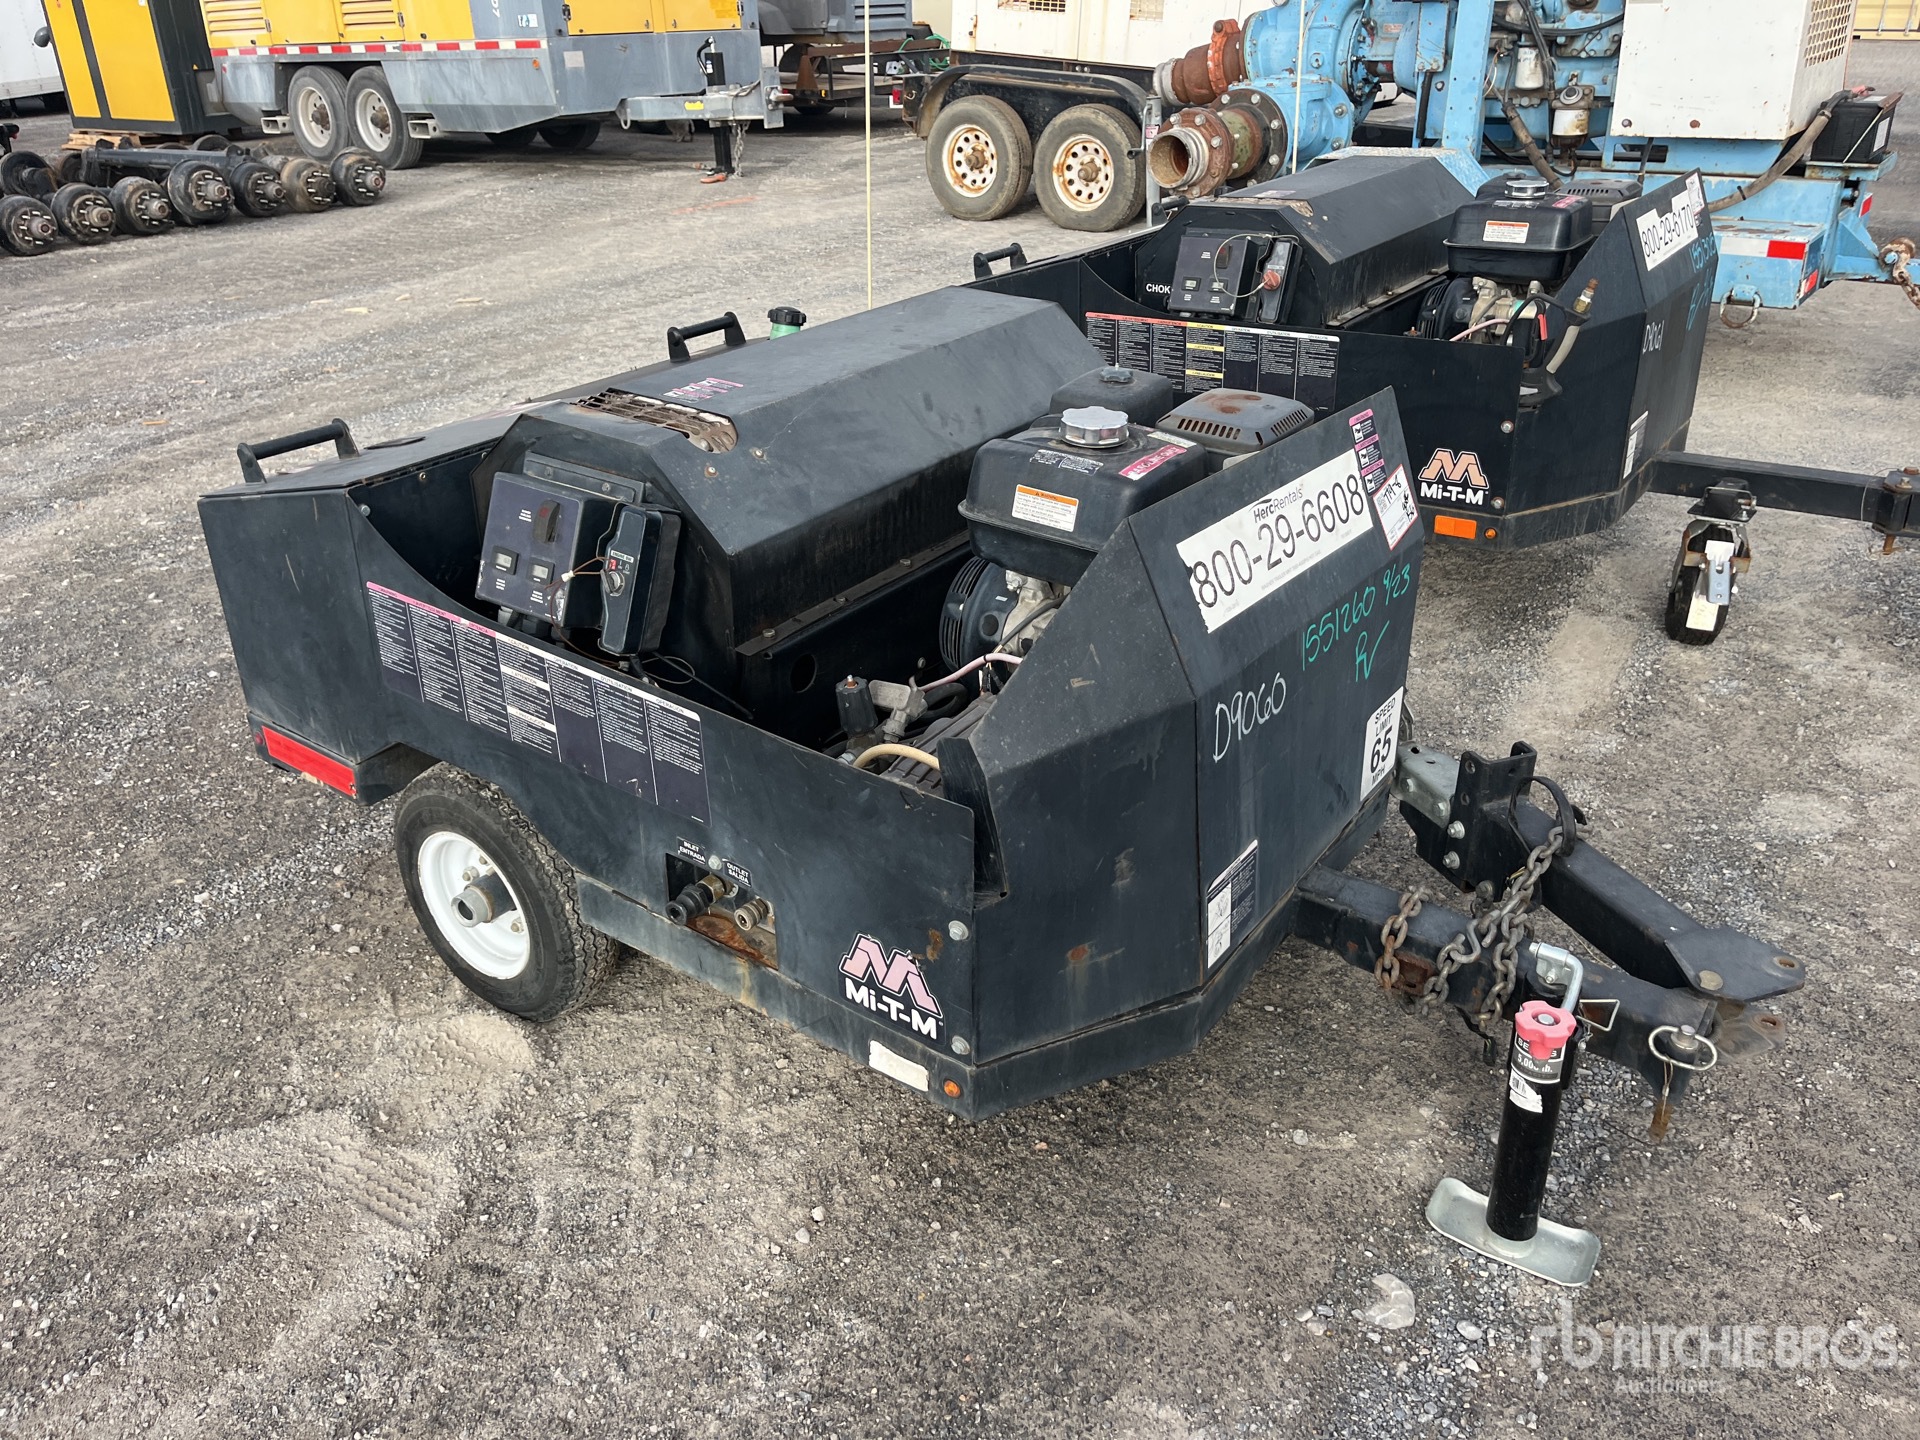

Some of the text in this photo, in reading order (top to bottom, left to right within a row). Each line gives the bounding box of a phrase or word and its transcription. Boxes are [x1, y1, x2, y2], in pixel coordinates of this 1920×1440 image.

[1641, 203, 1695, 259] 800-29-6170
[1145, 283, 1174, 295] CHOK
[1253, 485, 1304, 525] HercRentals
[1420, 481, 1485, 506] Mi-T-M
[1192, 474, 1365, 609] 800-29-6608
[1302, 586, 1376, 671] 1551260
[1212, 671, 1287, 764] D9060
[1374, 696, 1396, 725] SPEED
[1375, 712, 1393, 738] LIMIT
[1370, 724, 1393, 774] 65
[1371, 763, 1386, 786] MPH
[679, 846, 706, 862] ENTRADA
[683, 841, 700, 852] INLET
[726, 862, 749, 878] OUTLET
[728, 869, 750, 884] SALIDA
[844, 976, 938, 1041] Mi-T-M
